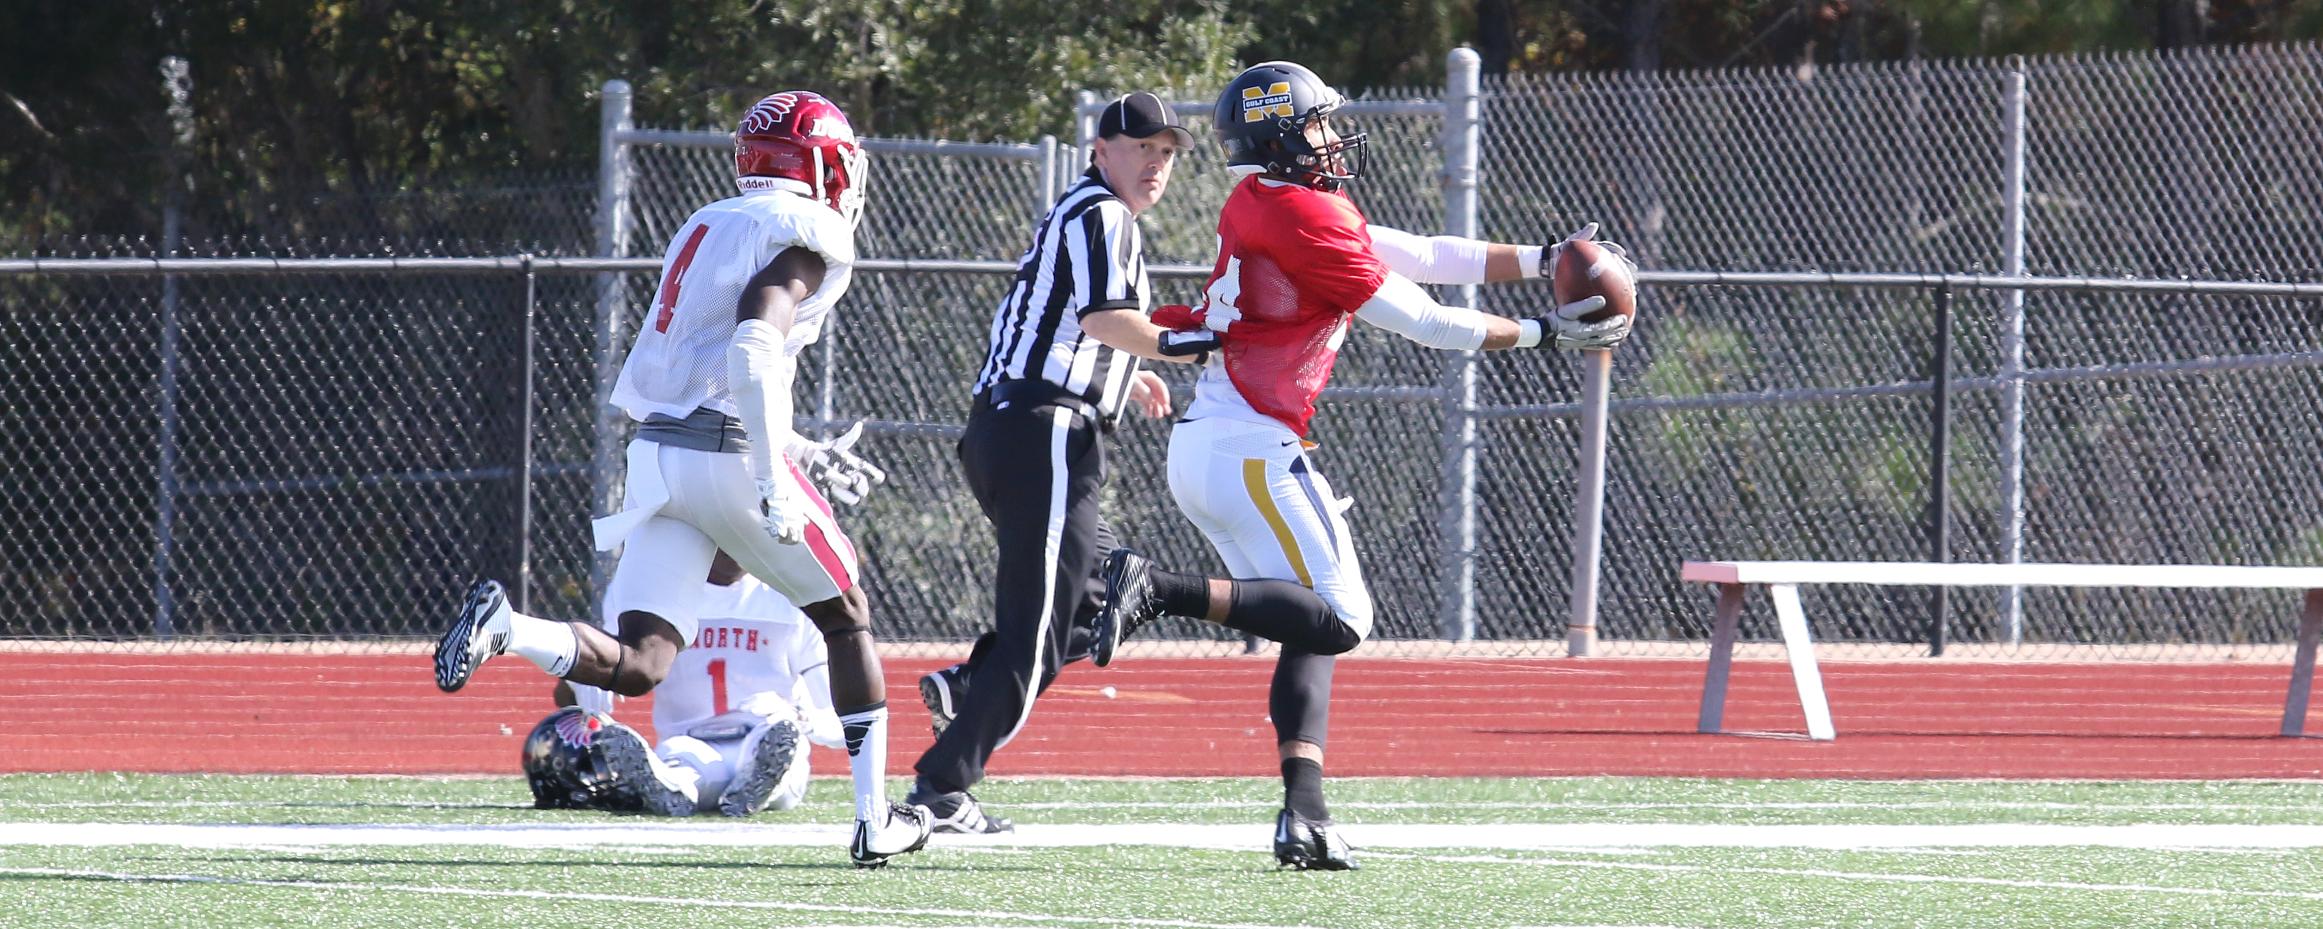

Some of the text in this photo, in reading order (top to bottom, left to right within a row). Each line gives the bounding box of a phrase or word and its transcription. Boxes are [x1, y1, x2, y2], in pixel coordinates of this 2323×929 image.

[1242, 81, 1294, 123] M
[1245, 95, 1289, 108] GULF COAST
[737, 179, 773, 189] Riddell
[655, 223, 710, 335] 4
[707, 657, 729, 717] 1
